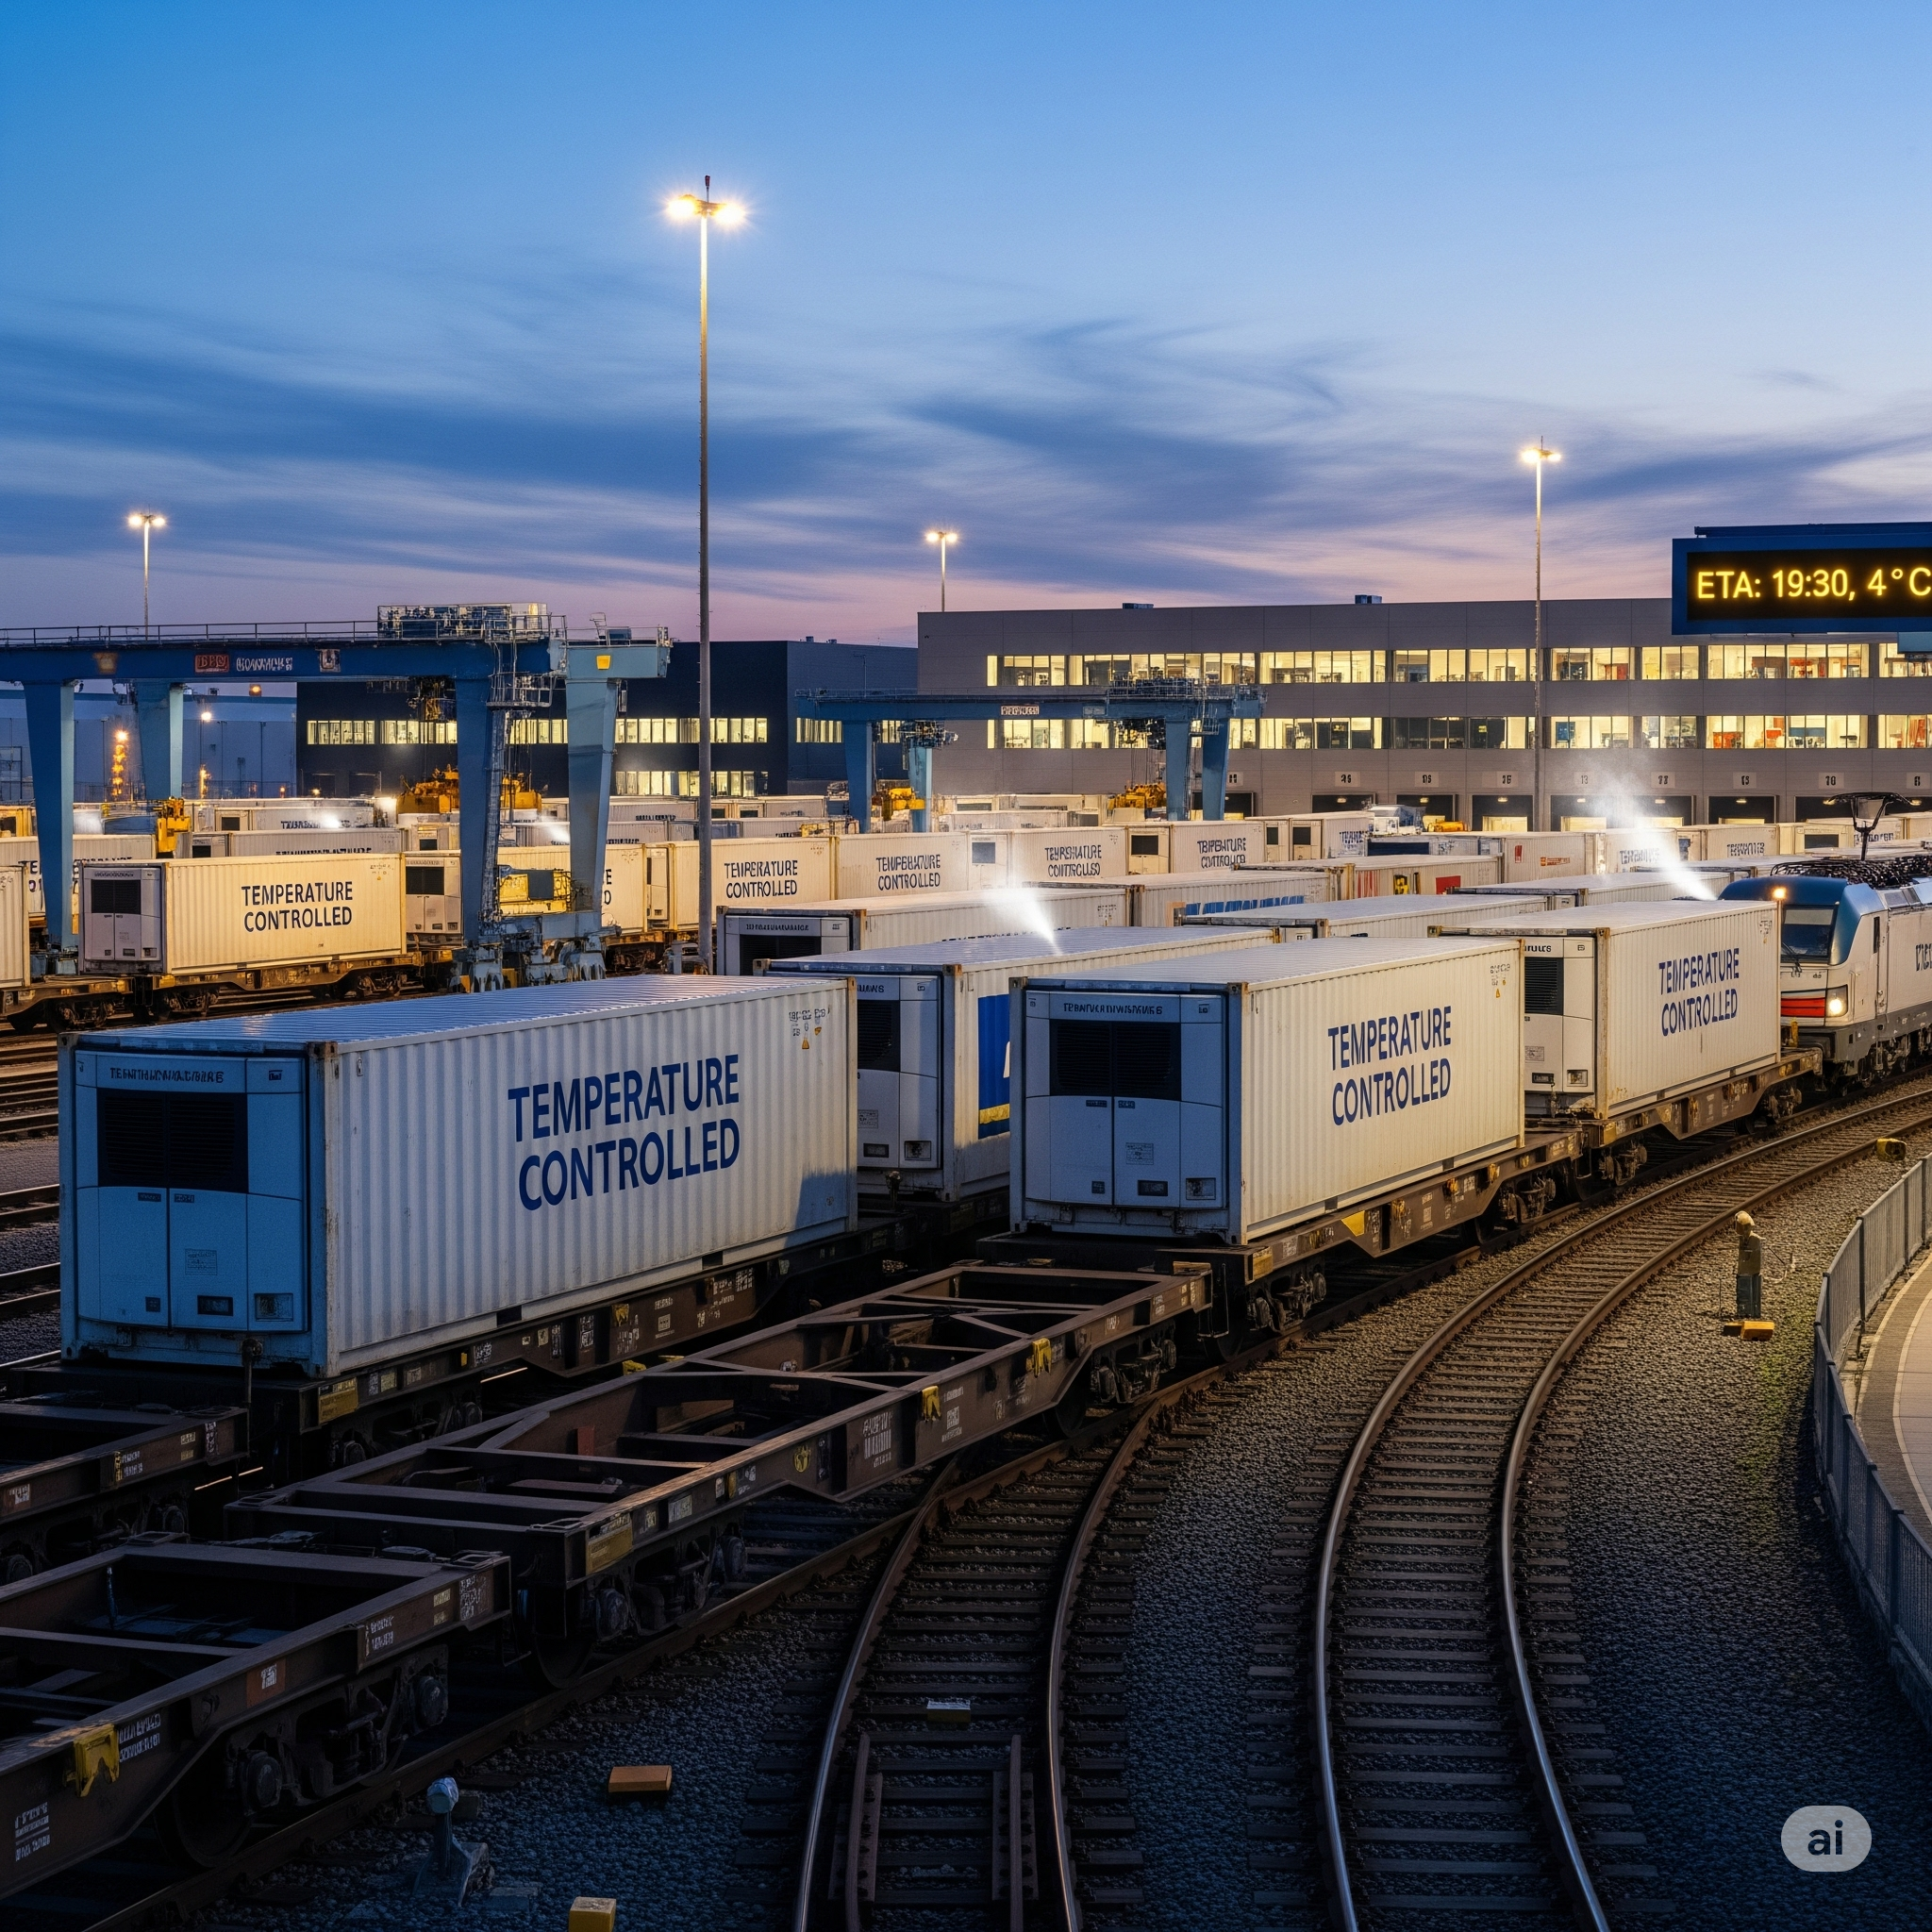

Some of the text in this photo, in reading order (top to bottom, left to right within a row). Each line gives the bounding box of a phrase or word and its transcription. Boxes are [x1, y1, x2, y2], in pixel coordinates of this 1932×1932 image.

[1697, 570, 1761, 599] ETA:
[1772, 568, 1857, 602] 19:30,
[241, 881, 354, 907] TEMPERATURE
[243, 906, 353, 933] CONTROLLED
[1658, 947, 1740, 996] TEMPERATURE
[1661, 988, 1738, 1037] CONTROLLED
[1327, 1005, 1452, 1071] TEMPERATURE
[508, 1054, 740, 1142] TEMPERATURE
[1332, 1058, 1452, 1126] CONTROLLED
[518, 1118, 741, 1211] CONTROLLED
